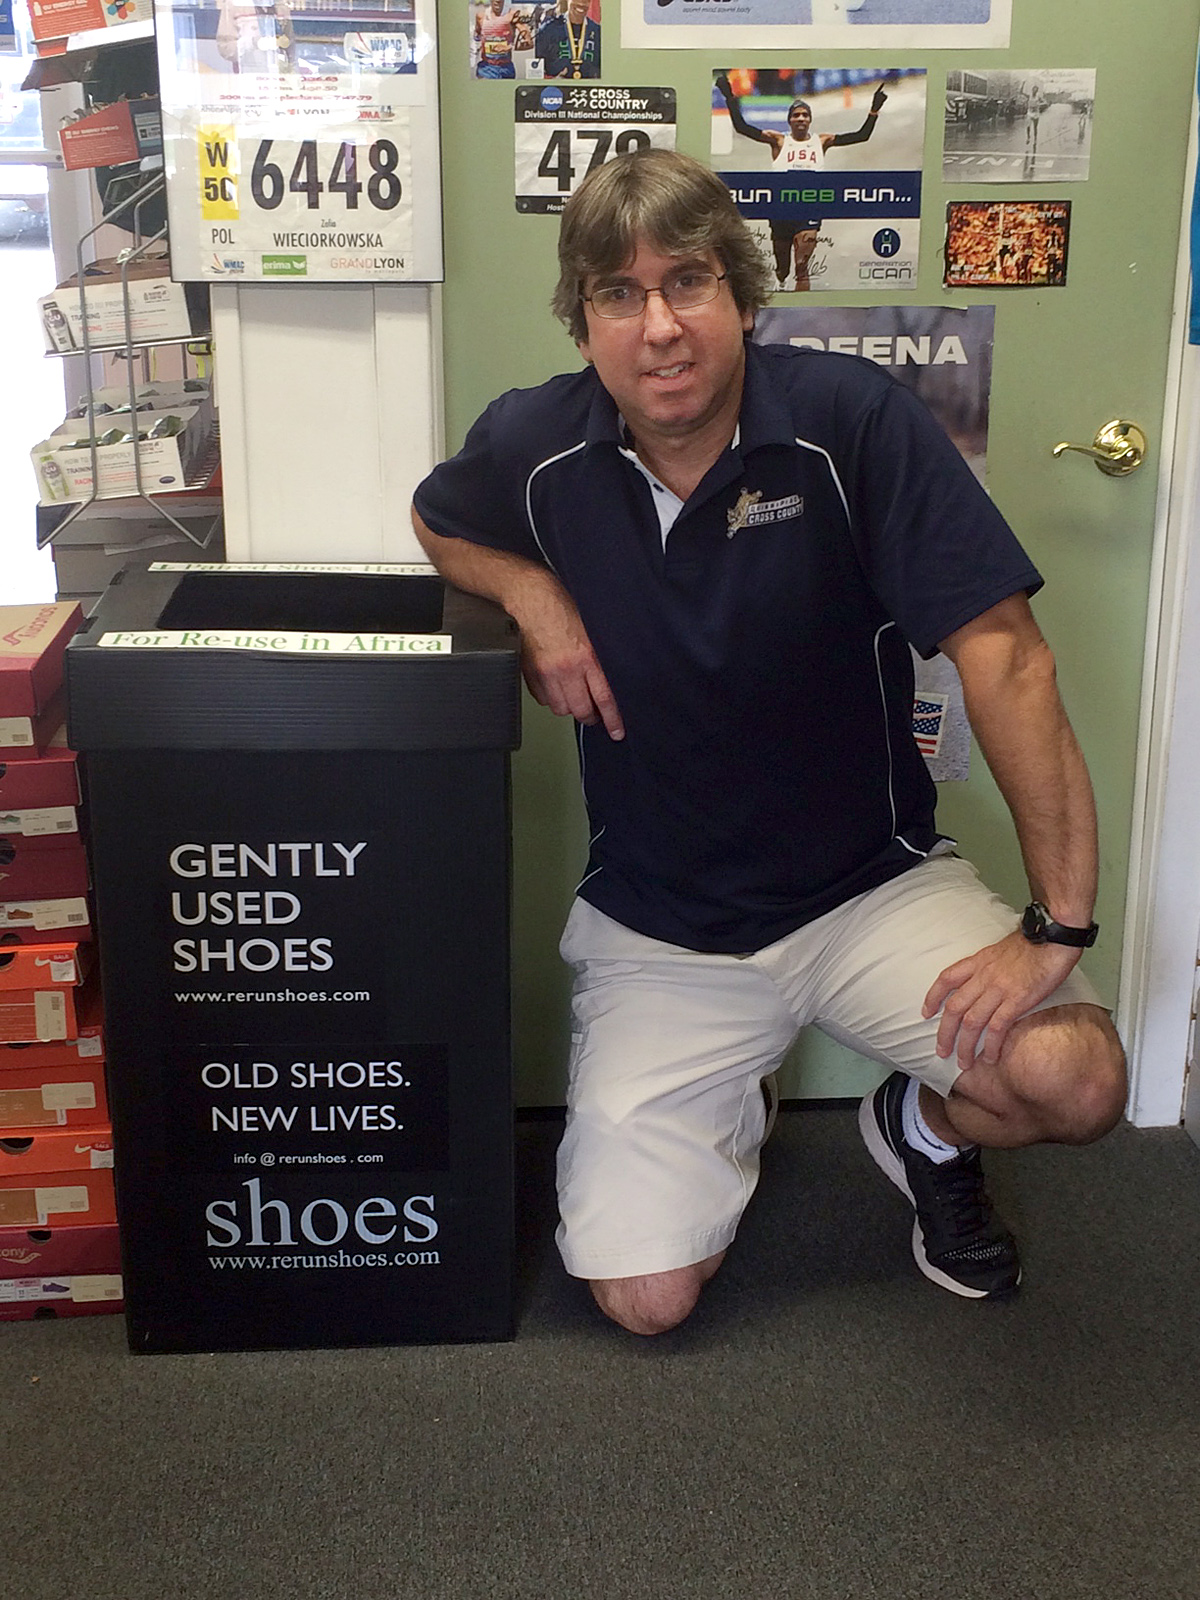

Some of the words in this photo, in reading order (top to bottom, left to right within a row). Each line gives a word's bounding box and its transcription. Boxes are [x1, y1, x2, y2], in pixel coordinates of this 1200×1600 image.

[590, 89, 630, 100] CROSS
[590, 99, 649, 110] COUNTRY
[524, 110, 557, 119] Division
[567, 111, 600, 119] National
[602, 111, 663, 120] Championships
[205, 141, 229, 168] W
[787, 150, 816, 163] USA
[251, 138, 402, 210] 6448
[843, 188, 912, 204] RUN...
[211, 228, 235, 244] POL
[273, 232, 384, 248] WIECIORKOWSKA
[263, 261, 291, 270] erima
[858, 267, 912, 280] UCAN
[749, 511, 775, 524] CROSS
[112, 633, 168, 645] For
[180, 632, 287, 649] Re-use
[301, 634, 330, 651] in
[344, 635, 442, 651] Africa
[169, 842, 368, 878] GENTLY
[171, 891, 301, 926] USED
[173, 938, 334, 972] SHOES
[174, 988, 371, 1003] www.rerunshoes.com
[201, 1062, 279, 1089] OLD
[290, 1061, 411, 1088] SHOES.
[211, 1106, 299, 1132] NEW
[310, 1105, 404, 1132] LIVES.
[233, 1153, 257, 1164] info
[260, 1152, 276, 1166] @
[279, 1152, 347, 1164] rerunshoes
[357, 1155, 384, 1164] com
[205, 1177, 439, 1248] shoes
[207, 1250, 441, 1270] www.rerunshoes.com
